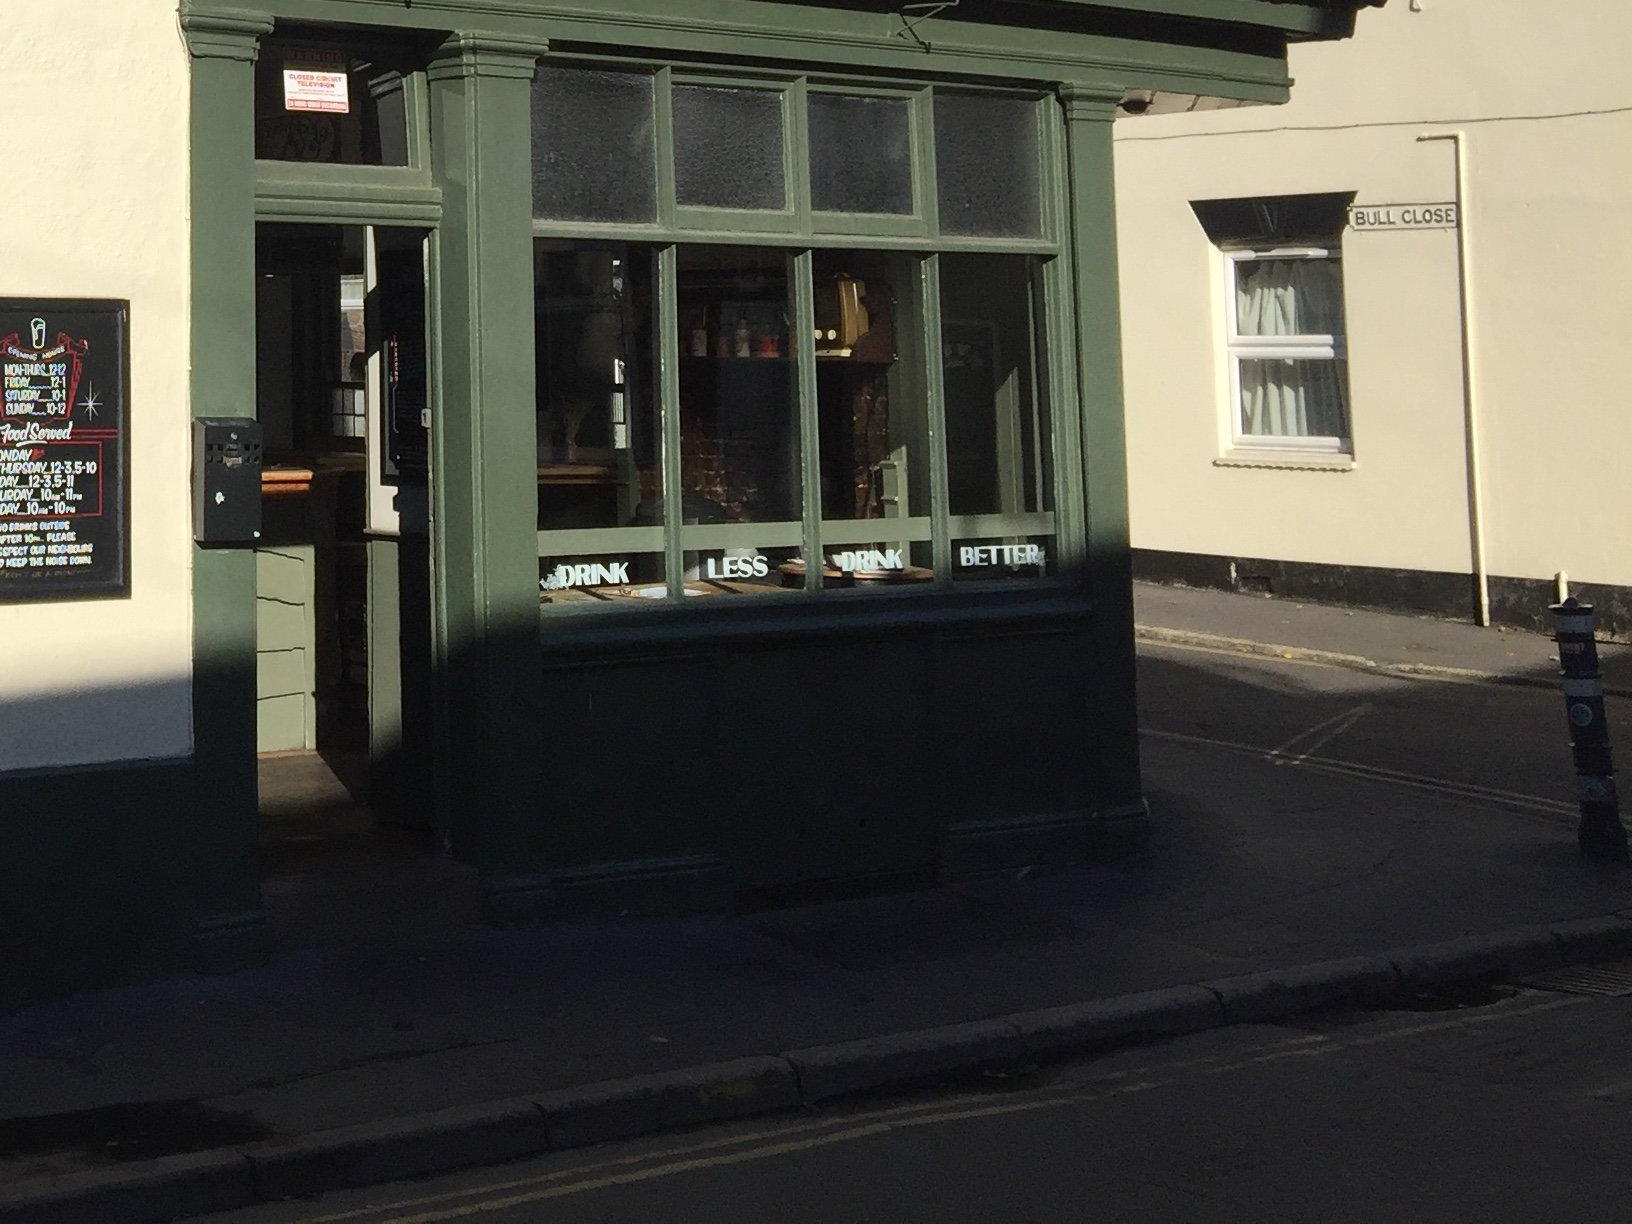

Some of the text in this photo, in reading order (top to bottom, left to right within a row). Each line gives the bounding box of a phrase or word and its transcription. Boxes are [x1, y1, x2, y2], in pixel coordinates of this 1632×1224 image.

[1355, 208, 1455, 225] BULL CLOSE
[4, 376, 66, 388] FRIDAY 12-1
[5, 389, 41, 401] SATURDAY
[5, 402, 66, 415] SUNDAY 10-12
[29, 421, 73, 440] Served
[558, 544, 1039, 588] DRINK LESS DRINK BETTER
